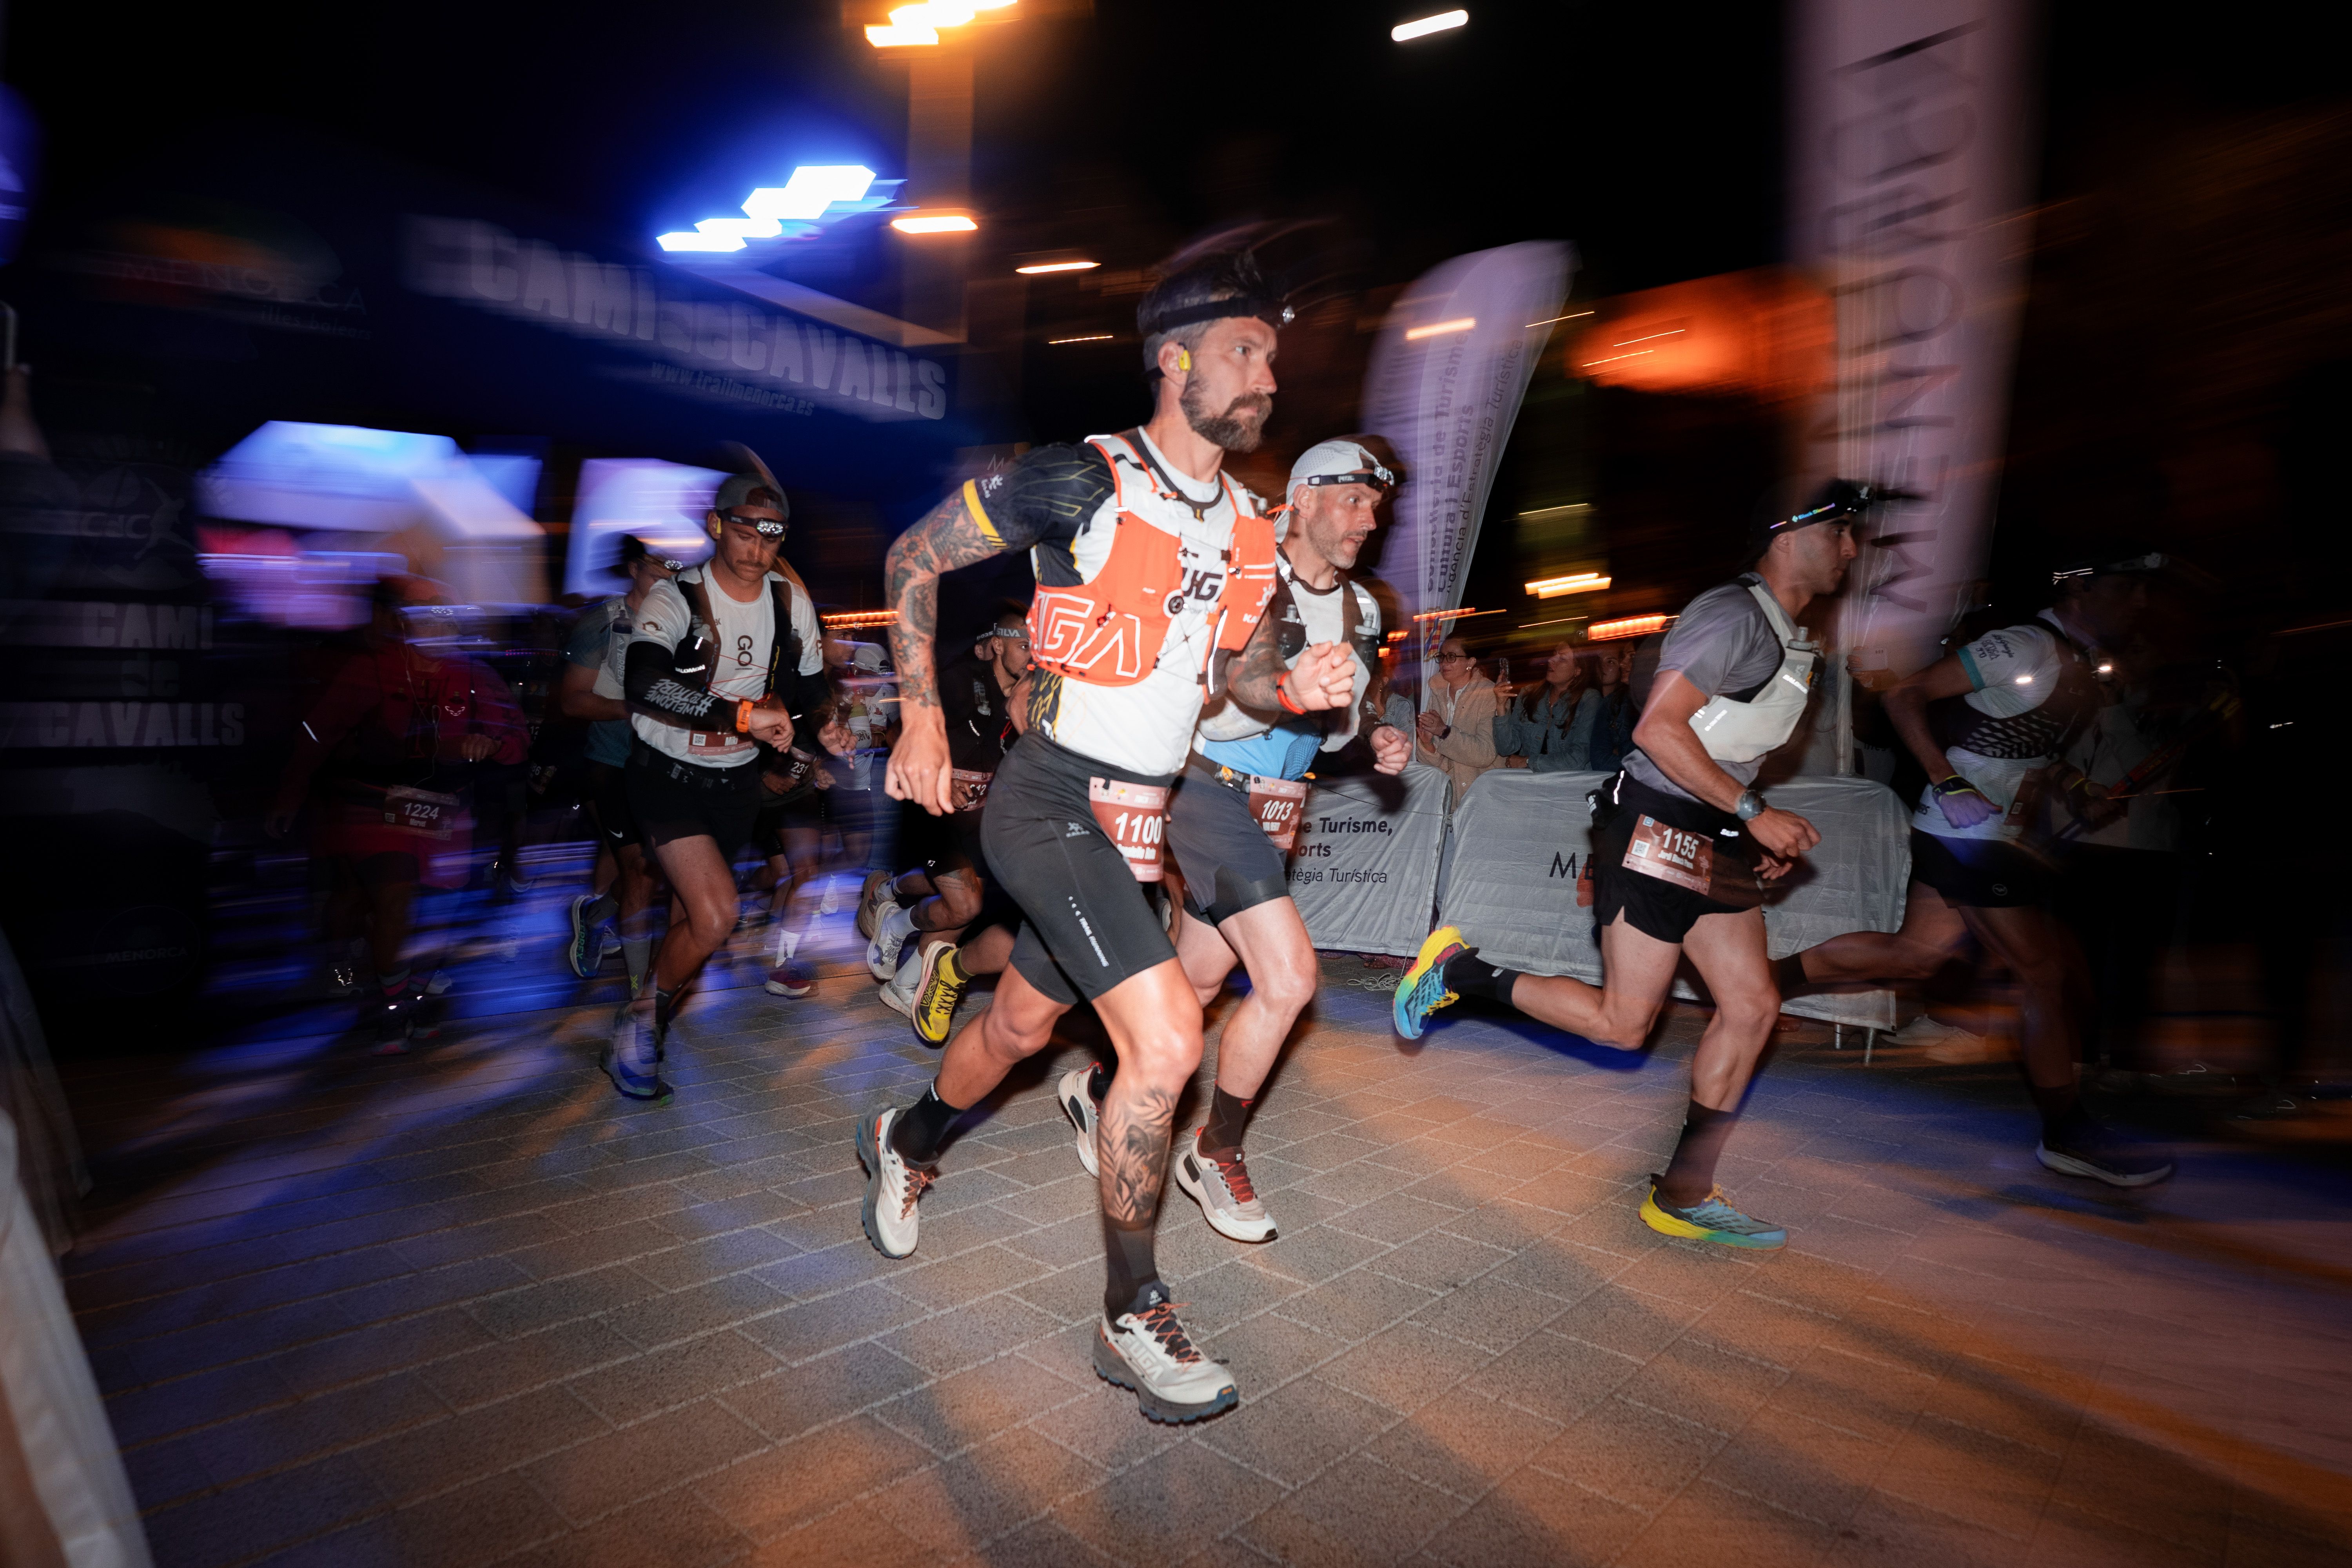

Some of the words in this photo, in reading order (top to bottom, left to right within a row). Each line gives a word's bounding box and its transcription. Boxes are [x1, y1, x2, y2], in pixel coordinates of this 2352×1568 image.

[731, 300, 946, 420] CAVALLS
[651, 361, 815, 417] www.trailmenorca.es
[996, 628, 1020, 637] SILVA
[40, 701, 245, 746] CAVALLS
[404, 802, 440, 820] 1224
[1261, 799, 1294, 821] 1013
[1115, 812, 1162, 844] 1100
[1319, 817, 1393, 837] Turisme,
[1663, 828, 1699, 860] 1155
[1329, 867, 1387, 883] Turística
[106, 946, 189, 962] MENORCA
[577, 916, 586, 960] TERREX
[1079, 916, 1093, 936] TRAIL
[1089, 936, 1110, 967] RUNNING
[920, 969, 940, 1007] HOKA
